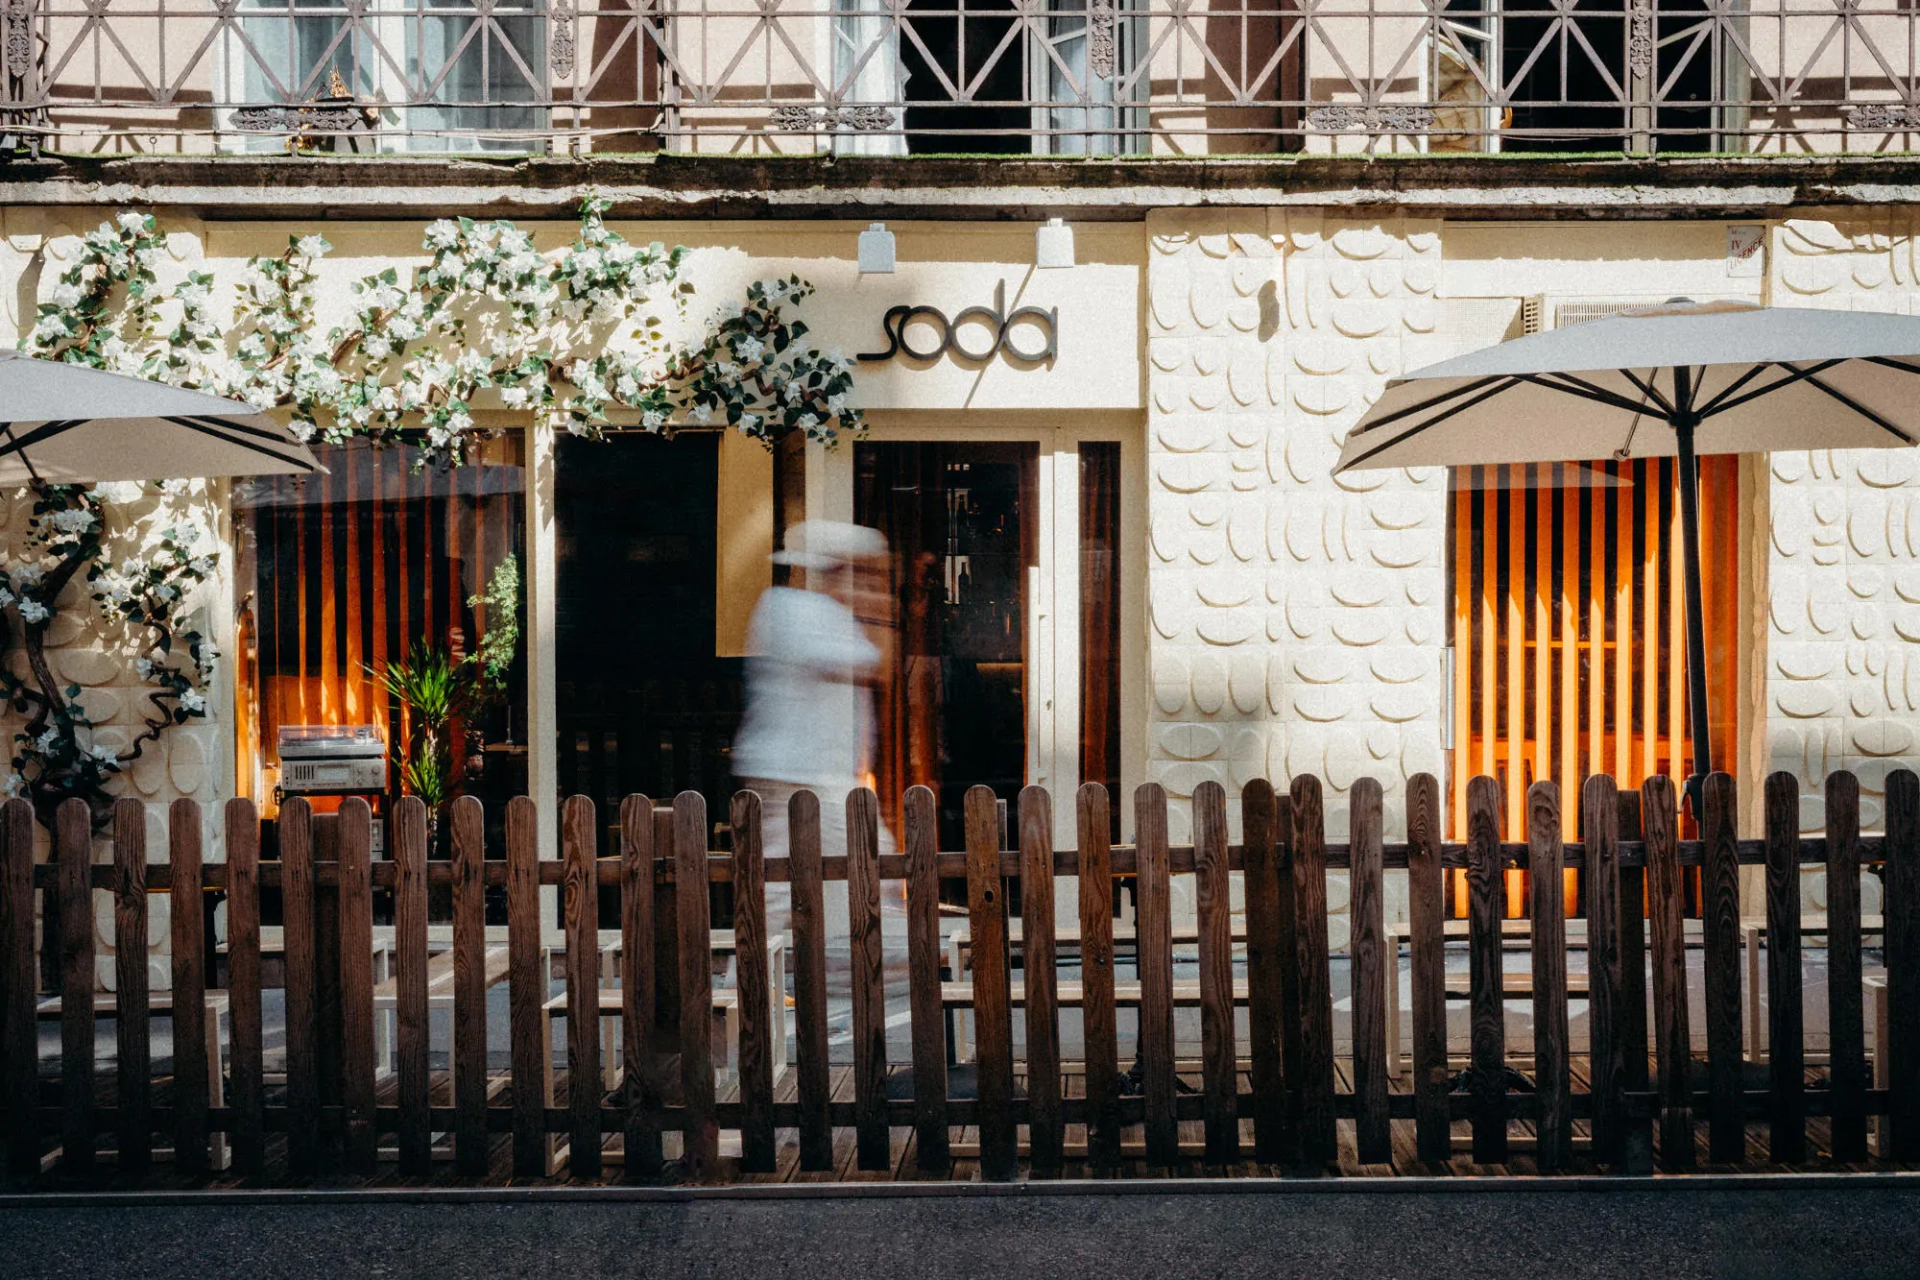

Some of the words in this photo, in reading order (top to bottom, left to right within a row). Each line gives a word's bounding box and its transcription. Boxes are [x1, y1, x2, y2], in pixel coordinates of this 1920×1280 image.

[1730, 236, 1764, 270] LICENCE
[1731, 240, 1742, 250] IV
[856, 278, 1059, 361] soda
